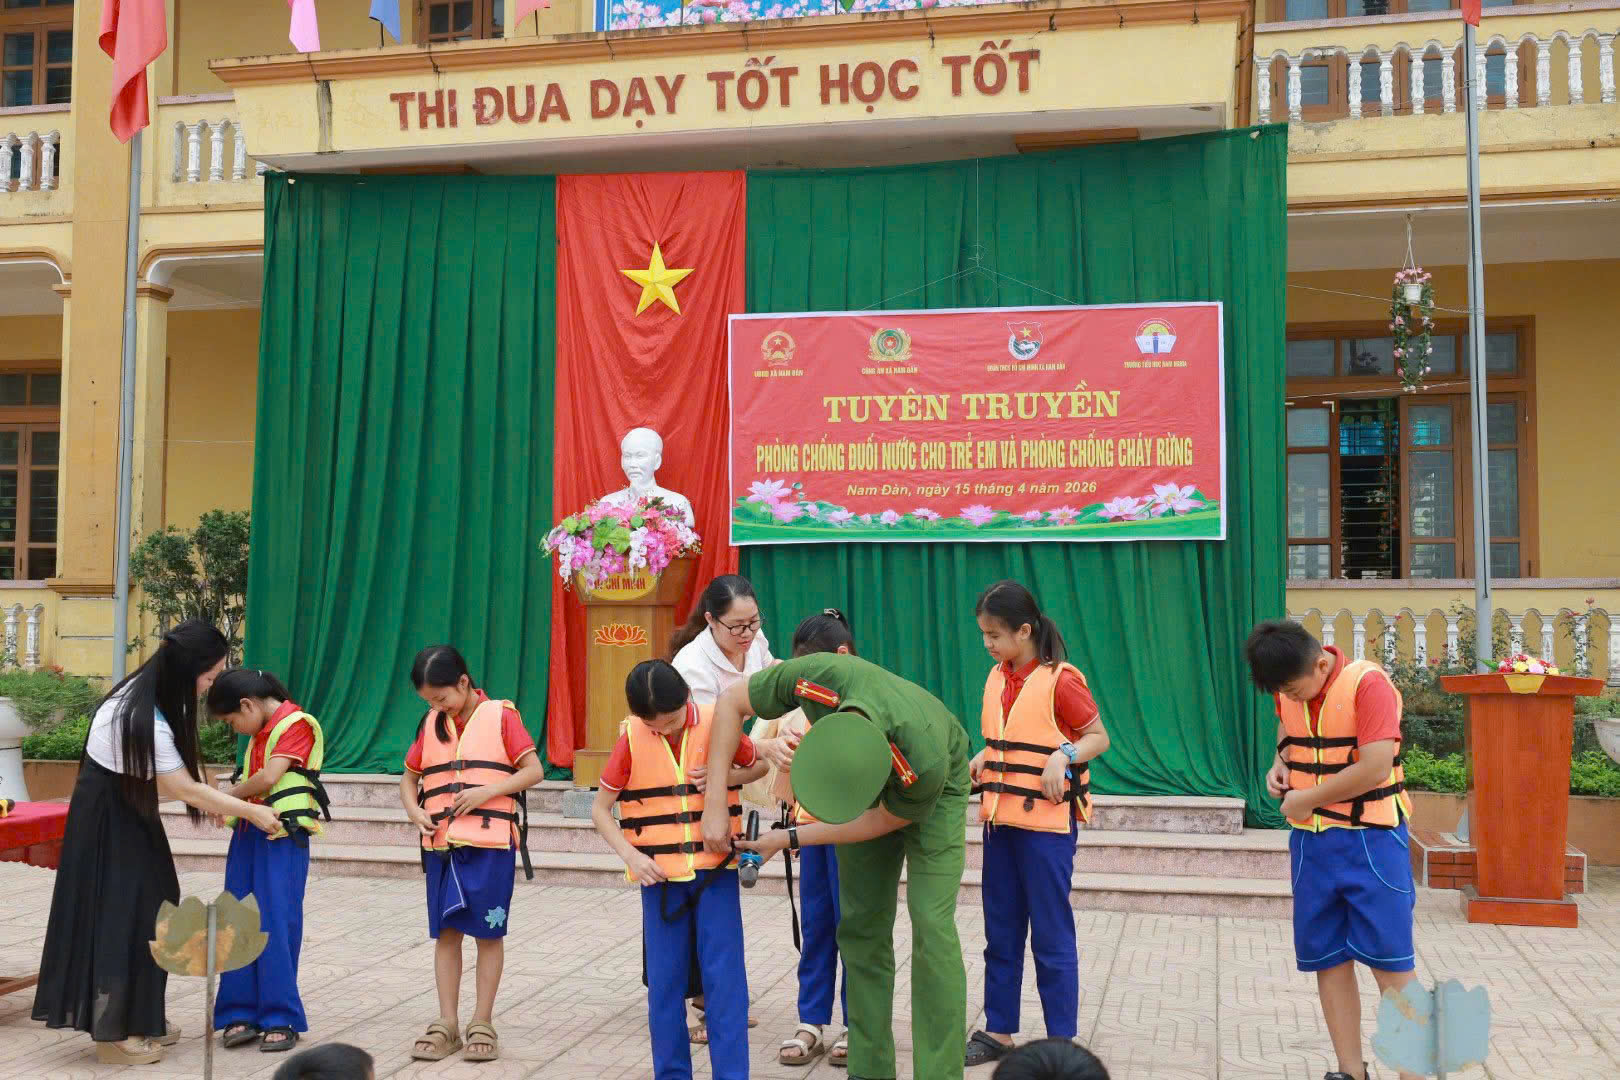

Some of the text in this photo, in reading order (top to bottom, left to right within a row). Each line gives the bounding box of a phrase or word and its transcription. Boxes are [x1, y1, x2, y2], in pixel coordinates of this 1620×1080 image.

[390, 38, 1041, 131] THI ĐUA DẠY TỐT HỌC TỐT
[823, 379, 1121, 422] TUYÊN TRUYỀN
[756, 428, 1193, 472] PHÒNG CHỐNG ĐUỐI NƯỚC CHO TRẺ EM VÀ PHÒNG CHỐNG CHÁY RỪNG
[847, 481, 1097, 500] Nam Đàn, ngày 15 tháng 4 năm 2026
